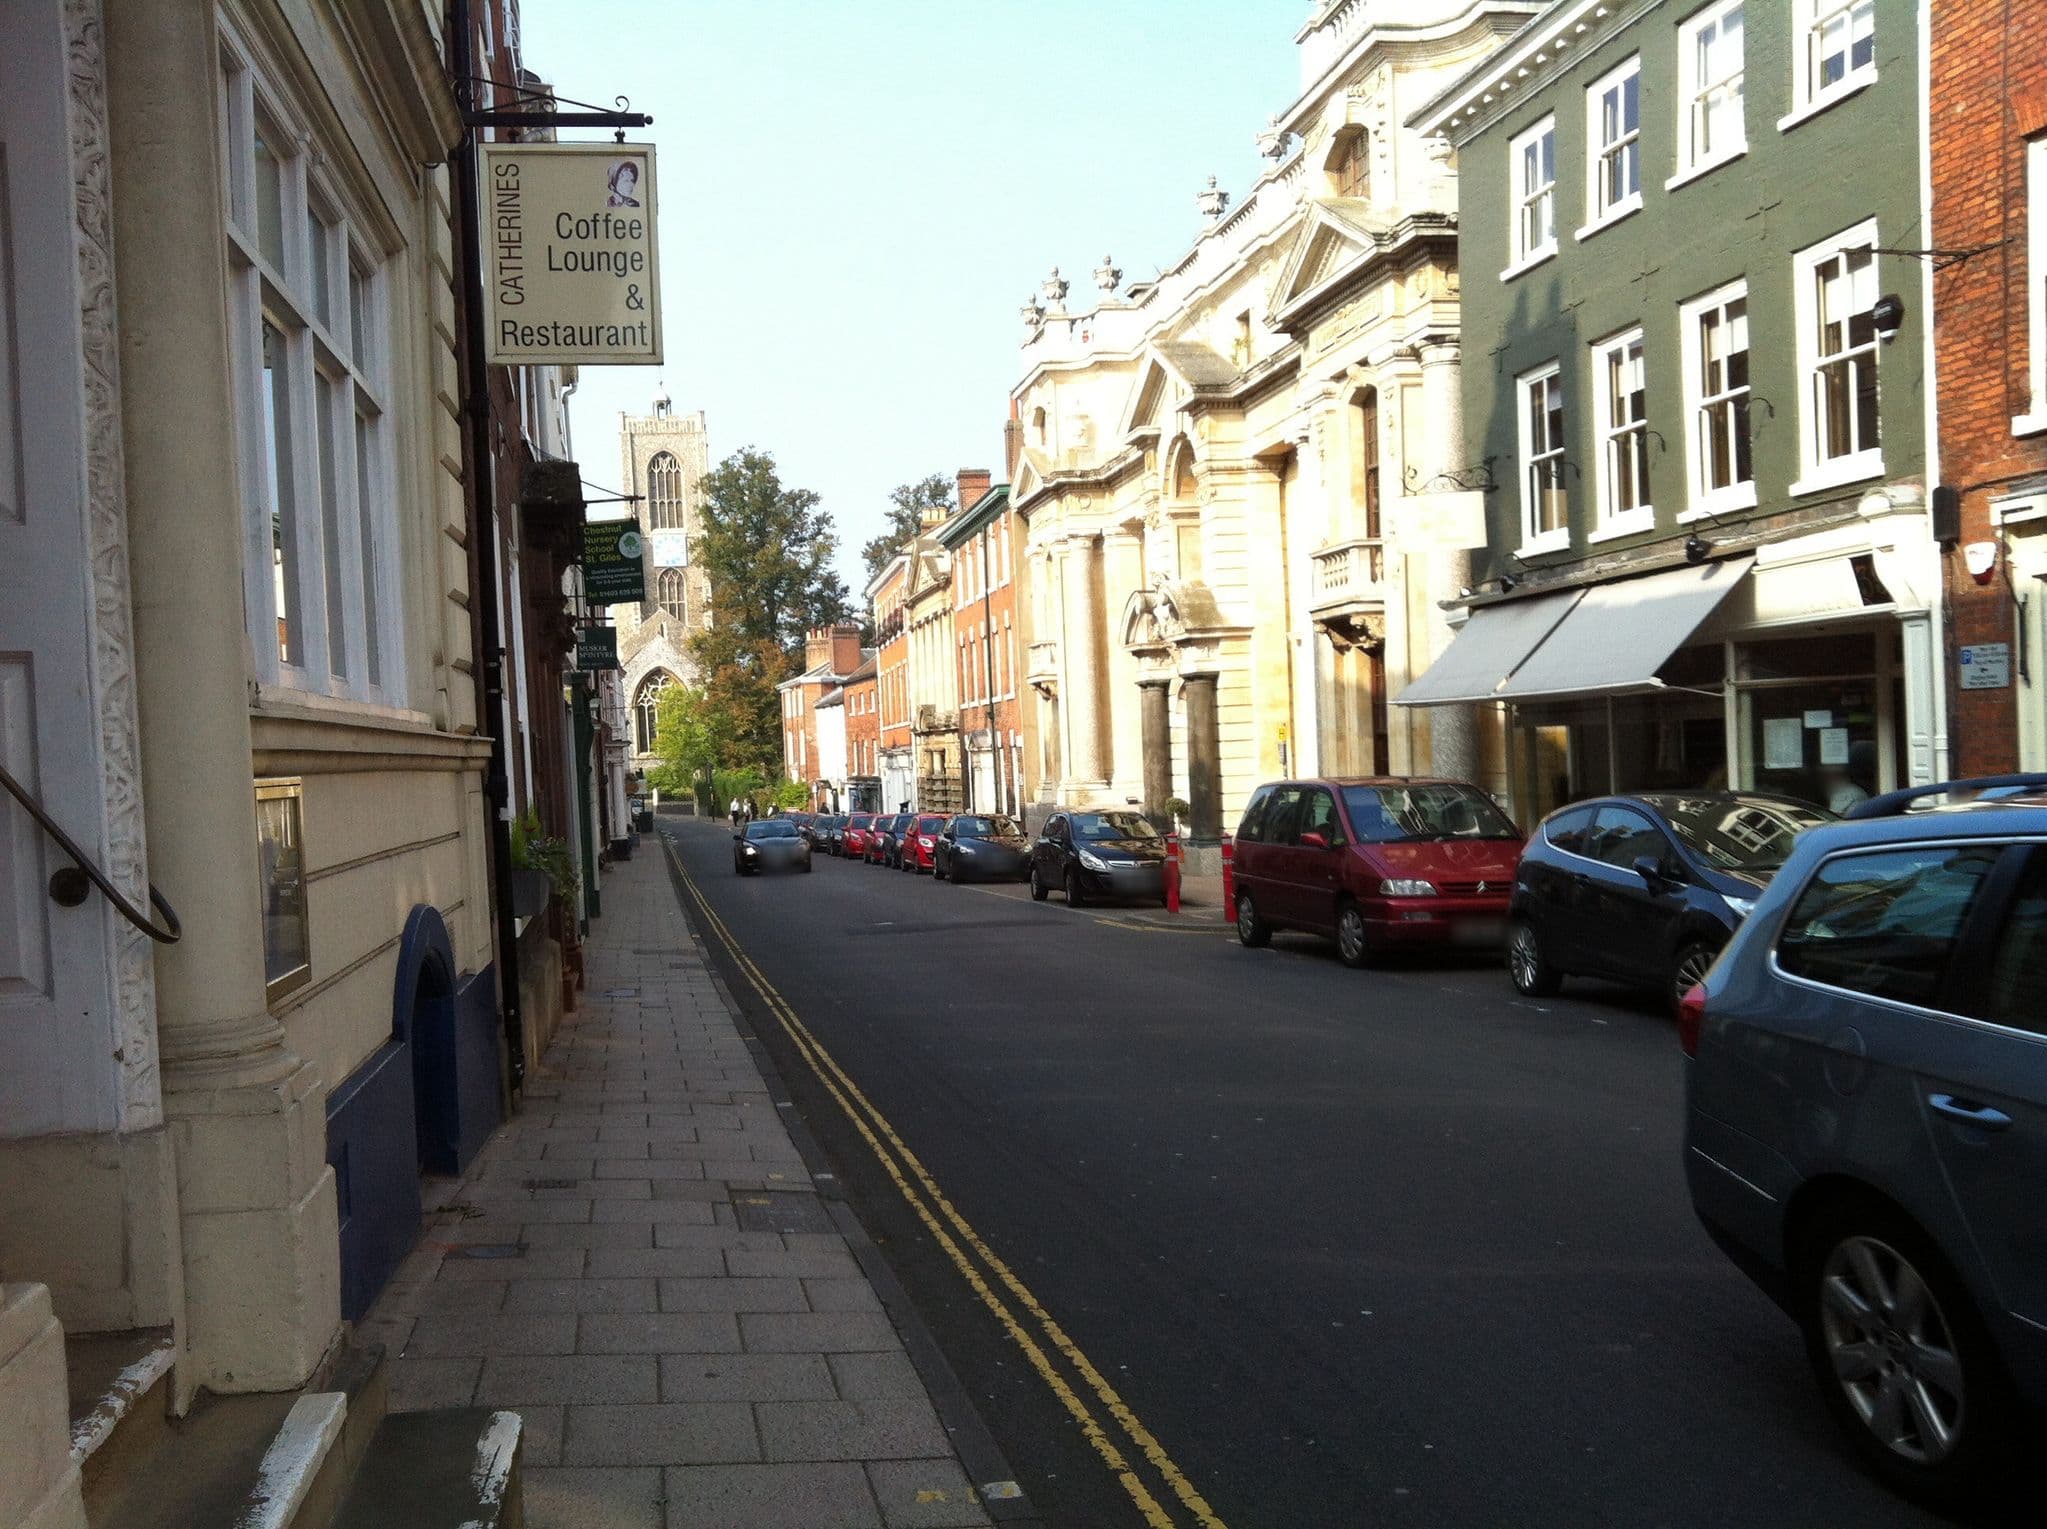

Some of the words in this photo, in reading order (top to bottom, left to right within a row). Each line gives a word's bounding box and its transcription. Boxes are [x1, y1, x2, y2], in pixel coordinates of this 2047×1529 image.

[495, 163, 525, 305] CATHERINES
[556, 212, 642, 240] Coffee
[547, 245, 643, 277] Lounge
[625, 284, 644, 310] &
[501, 319, 648, 347] Restaurant
[583, 525, 622, 535] Chestnut
[584, 536, 619, 544] Nursery
[585, 545, 615, 554] School
